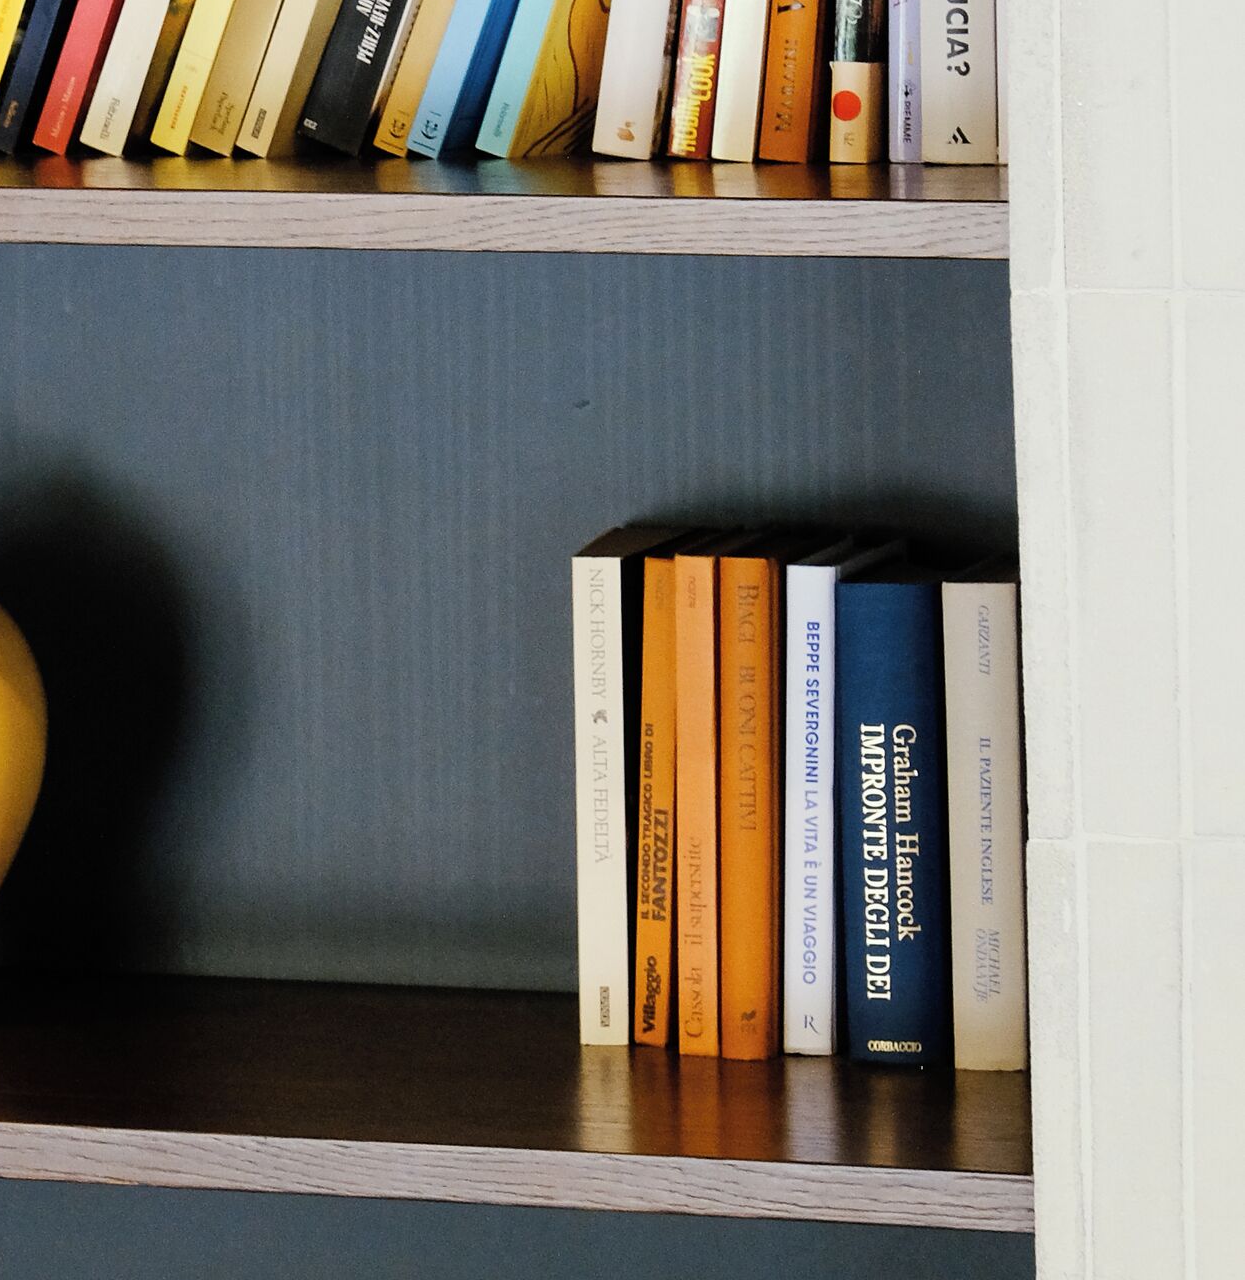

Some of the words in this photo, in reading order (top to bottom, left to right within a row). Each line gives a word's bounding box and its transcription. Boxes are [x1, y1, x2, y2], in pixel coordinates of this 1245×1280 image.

[681, 51, 715, 101] COOK
[588, 568, 604, 614] NICK
[737, 583, 759, 643] BIAGI
[589, 620, 606, 699] HORNBY
[805, 621, 819, 672] BEPPE
[977, 604, 990, 675] GARZANTI
[645, 723, 653, 736] DI
[738, 665, 755, 735] BUONI
[804, 678, 818, 783] SEVERGNINI
[591, 734, 607, 781] ALTA
[644, 741, 653, 778] LIBRO
[891, 724, 918, 823] Graham
[979, 736, 990, 752] IL
[642, 783, 653, 839] TRAGICO
[739, 743, 756, 830] CATTIVI
[804, 789, 817, 809] LA
[859, 722, 887, 860] IMPRONTE
[979, 756, 991, 832] PAZIENTE
[593, 788, 612, 862] FEDELTÀ
[803, 815, 817, 853] VITA
[640, 843, 651, 904] SECONDO
[651, 809, 669, 921] FANTOZZI
[684, 836, 706, 928] superstite
[803, 860, 822, 868] È
[803, 874, 817, 899] UN
[894, 831, 920, 941] Hancock
[979, 837, 992, 905] INGLESE
[640, 908, 649, 919] IL
[684, 933, 702, 945] il
[863, 866, 889, 948] DEGLI
[802, 904, 816, 984] VIAGGIO
[865, 953, 890, 1000] DEI
[971, 927, 988, 1002] ONDAATJE
[987, 928, 1000, 997] MICHAEL
[642, 955, 661, 1033] Villaggio
[684, 967, 703, 1037] Cassola
[867, 1040, 922, 1053] CORBACCIO
